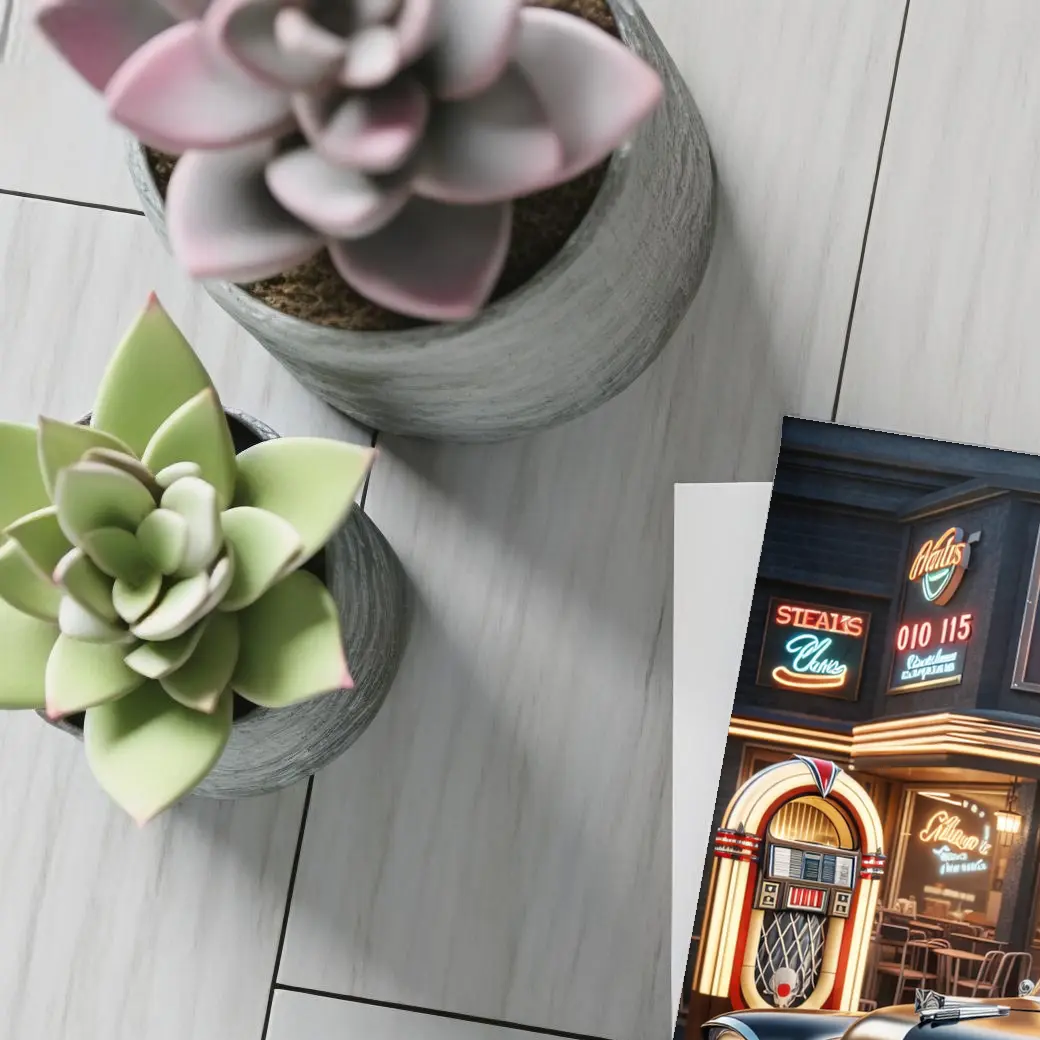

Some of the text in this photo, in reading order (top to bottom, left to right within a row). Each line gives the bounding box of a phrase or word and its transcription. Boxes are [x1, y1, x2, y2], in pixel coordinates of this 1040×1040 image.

[775, 605, 864, 637] STEAKS
[896, 613, 973, 651] 010 115
